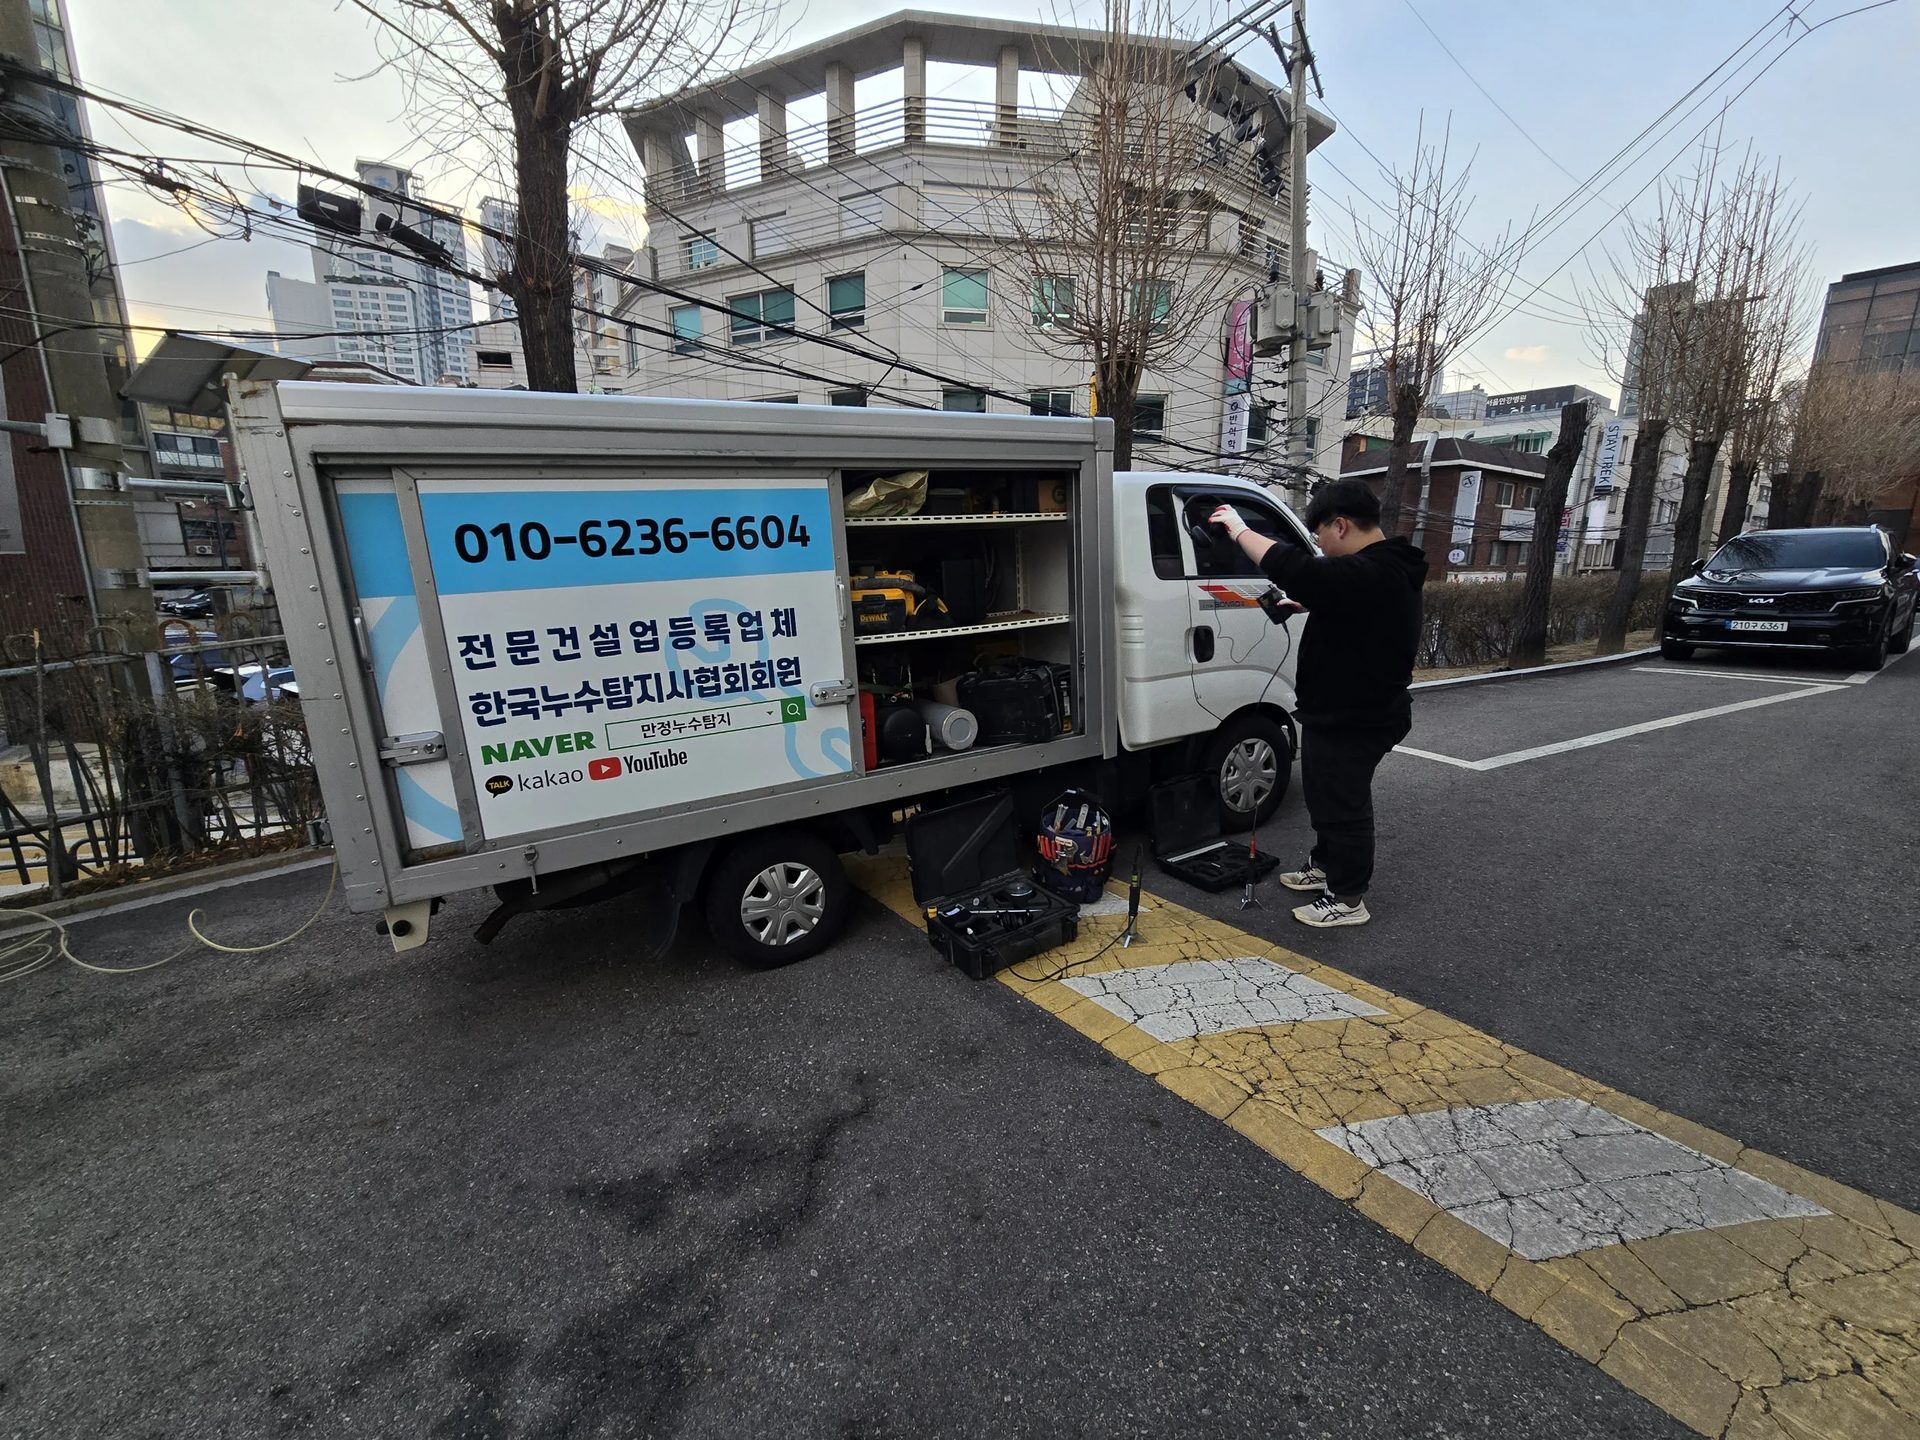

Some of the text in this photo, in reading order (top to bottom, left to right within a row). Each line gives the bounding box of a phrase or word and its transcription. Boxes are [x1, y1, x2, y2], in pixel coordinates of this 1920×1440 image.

[1228, 414, 1238, 452] 반석학
[1598, 425, 1620, 484] STAY TREK
[455, 515, 810, 563] 010-6236-6604
[1760, 622, 1785, 631] 6361
[468, 656, 802, 727] 한국누수탐지사협회회원
[640, 712, 731, 739] 만정누수탐지
[481, 731, 596, 766] NAVER
[488, 749, 688, 792] TALK kakao YouTube
